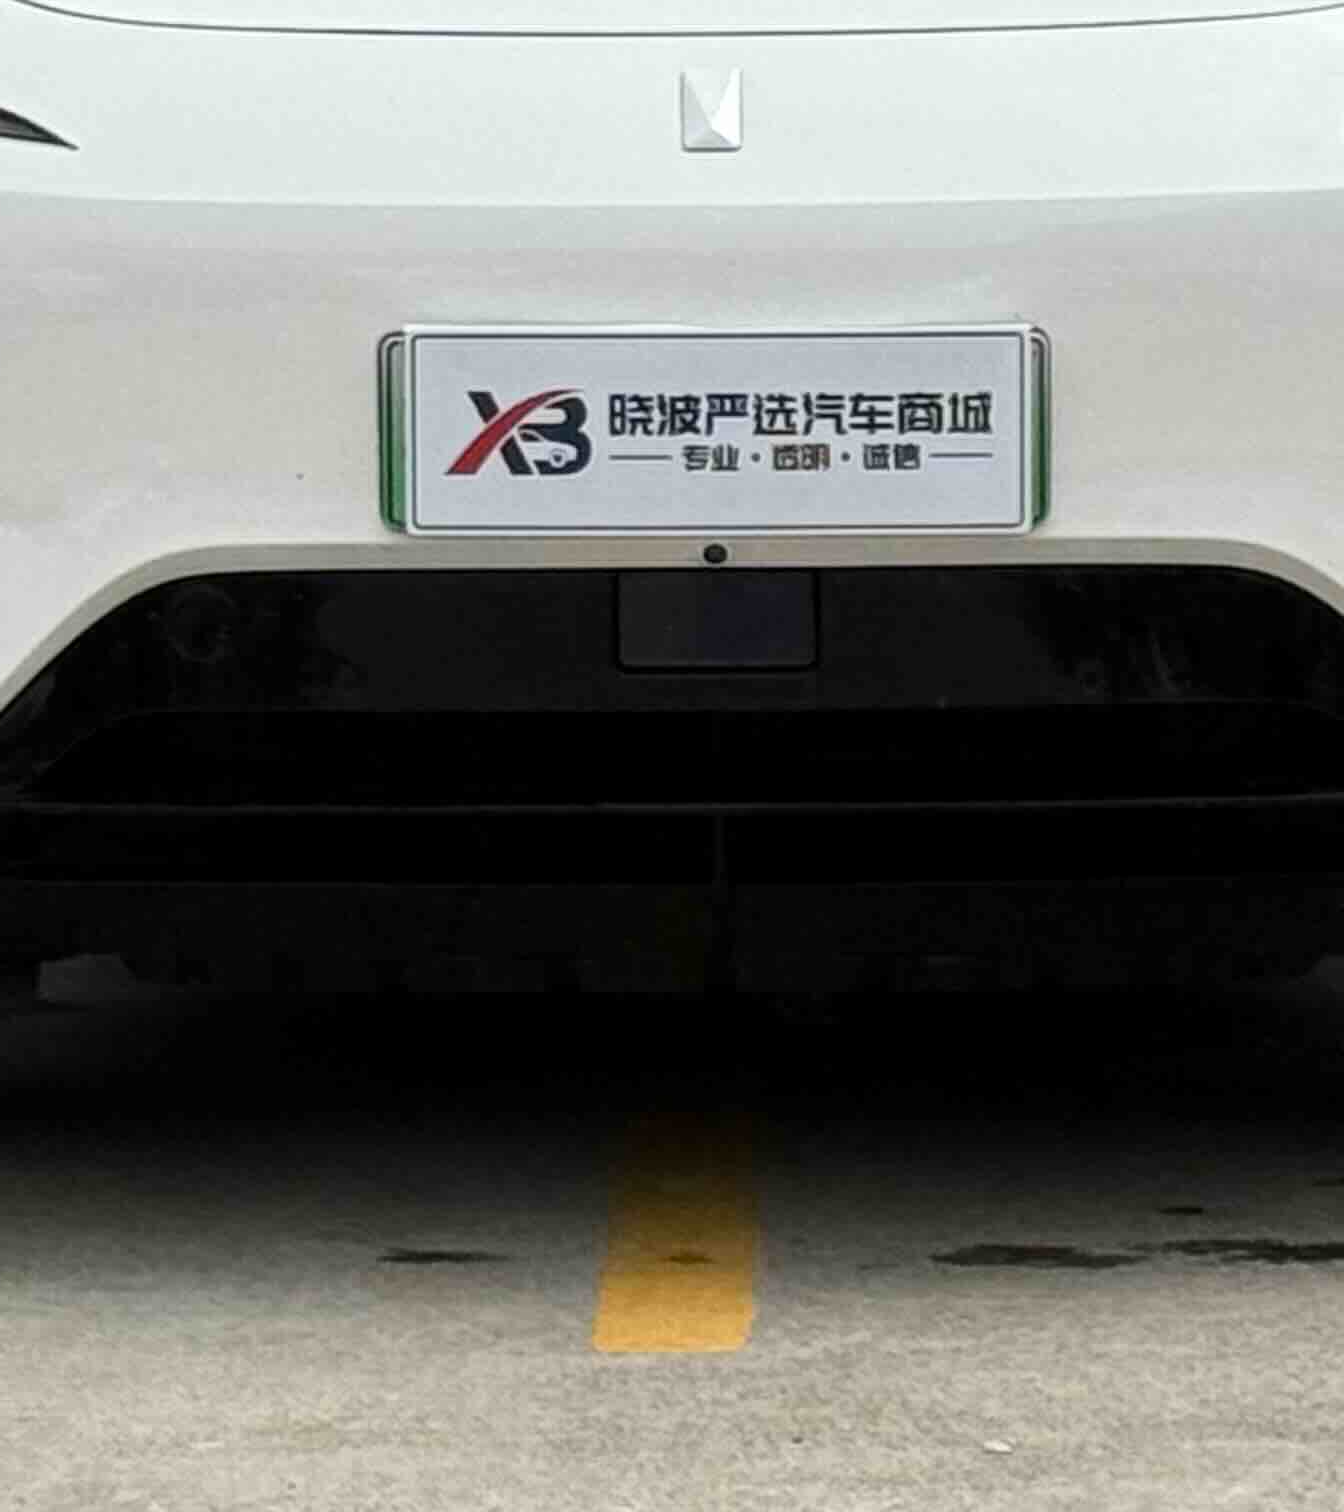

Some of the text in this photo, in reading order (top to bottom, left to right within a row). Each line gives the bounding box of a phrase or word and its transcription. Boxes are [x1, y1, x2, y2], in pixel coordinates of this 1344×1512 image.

[609, 392, 994, 437] 晓波严选汽车商城
